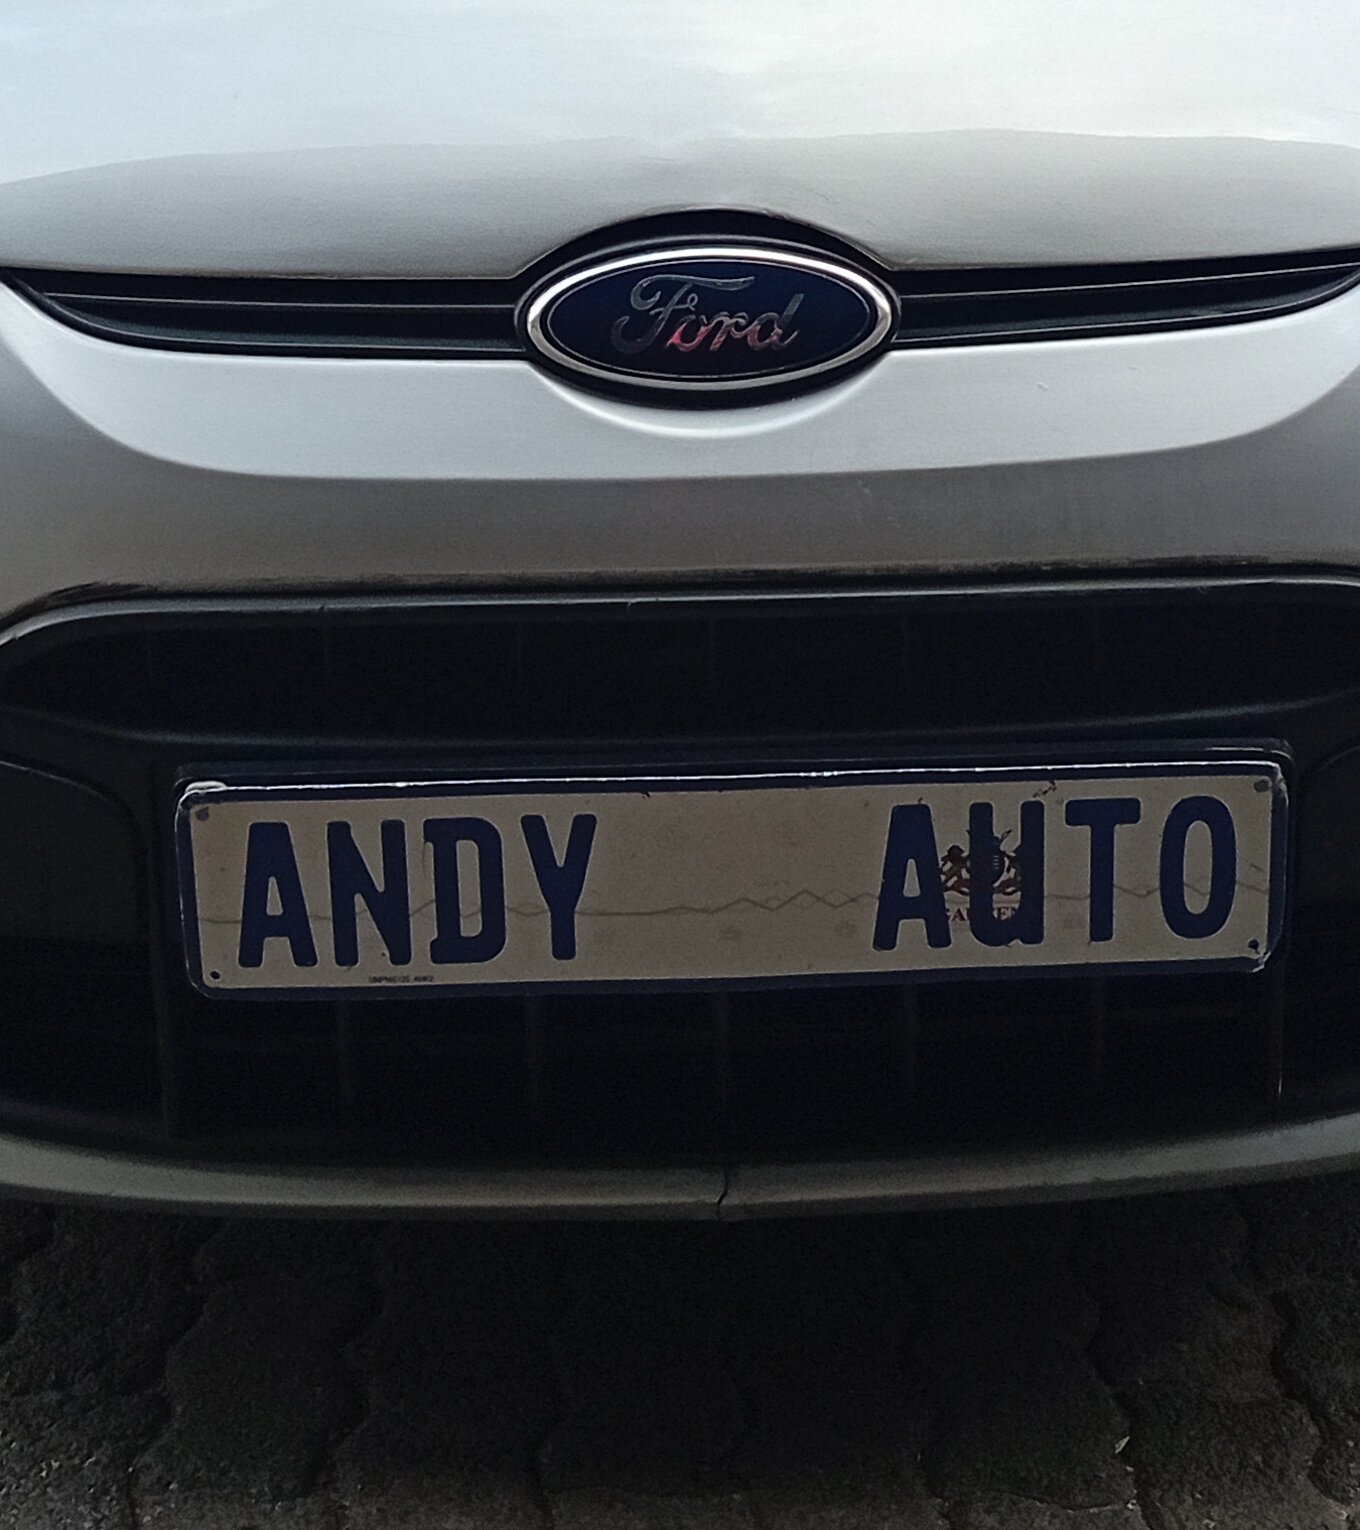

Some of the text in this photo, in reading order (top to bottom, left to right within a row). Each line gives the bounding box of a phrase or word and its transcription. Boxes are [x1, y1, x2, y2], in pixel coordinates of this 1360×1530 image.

[610, 274, 805, 354] Ford
[238, 795, 1237, 968] ANDY AUTO
